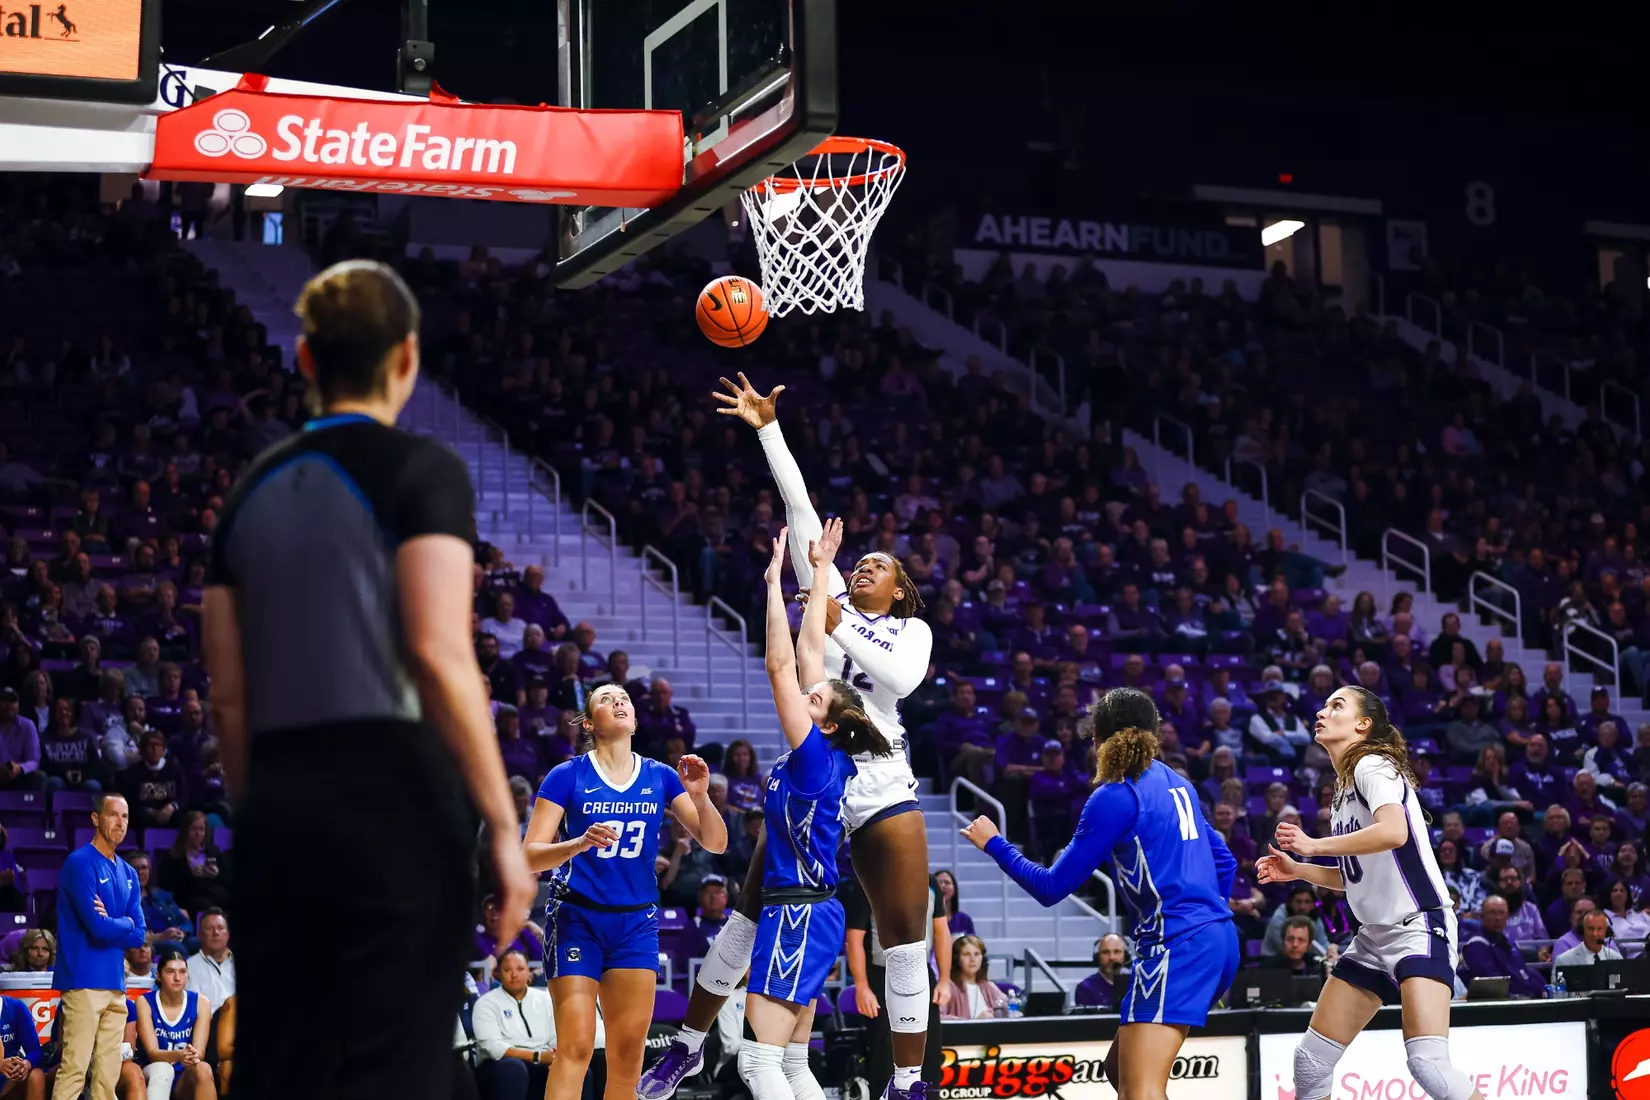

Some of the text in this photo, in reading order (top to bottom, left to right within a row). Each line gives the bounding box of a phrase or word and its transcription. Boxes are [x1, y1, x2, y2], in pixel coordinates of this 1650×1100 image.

[1464, 180, 1497, 226] 8
[582, 801, 658, 815] CREIGHTON
[1167, 786, 1199, 841] 11
[31, 1001, 51, 1023] G
[950, 1086, 992, 1098] GROUP
